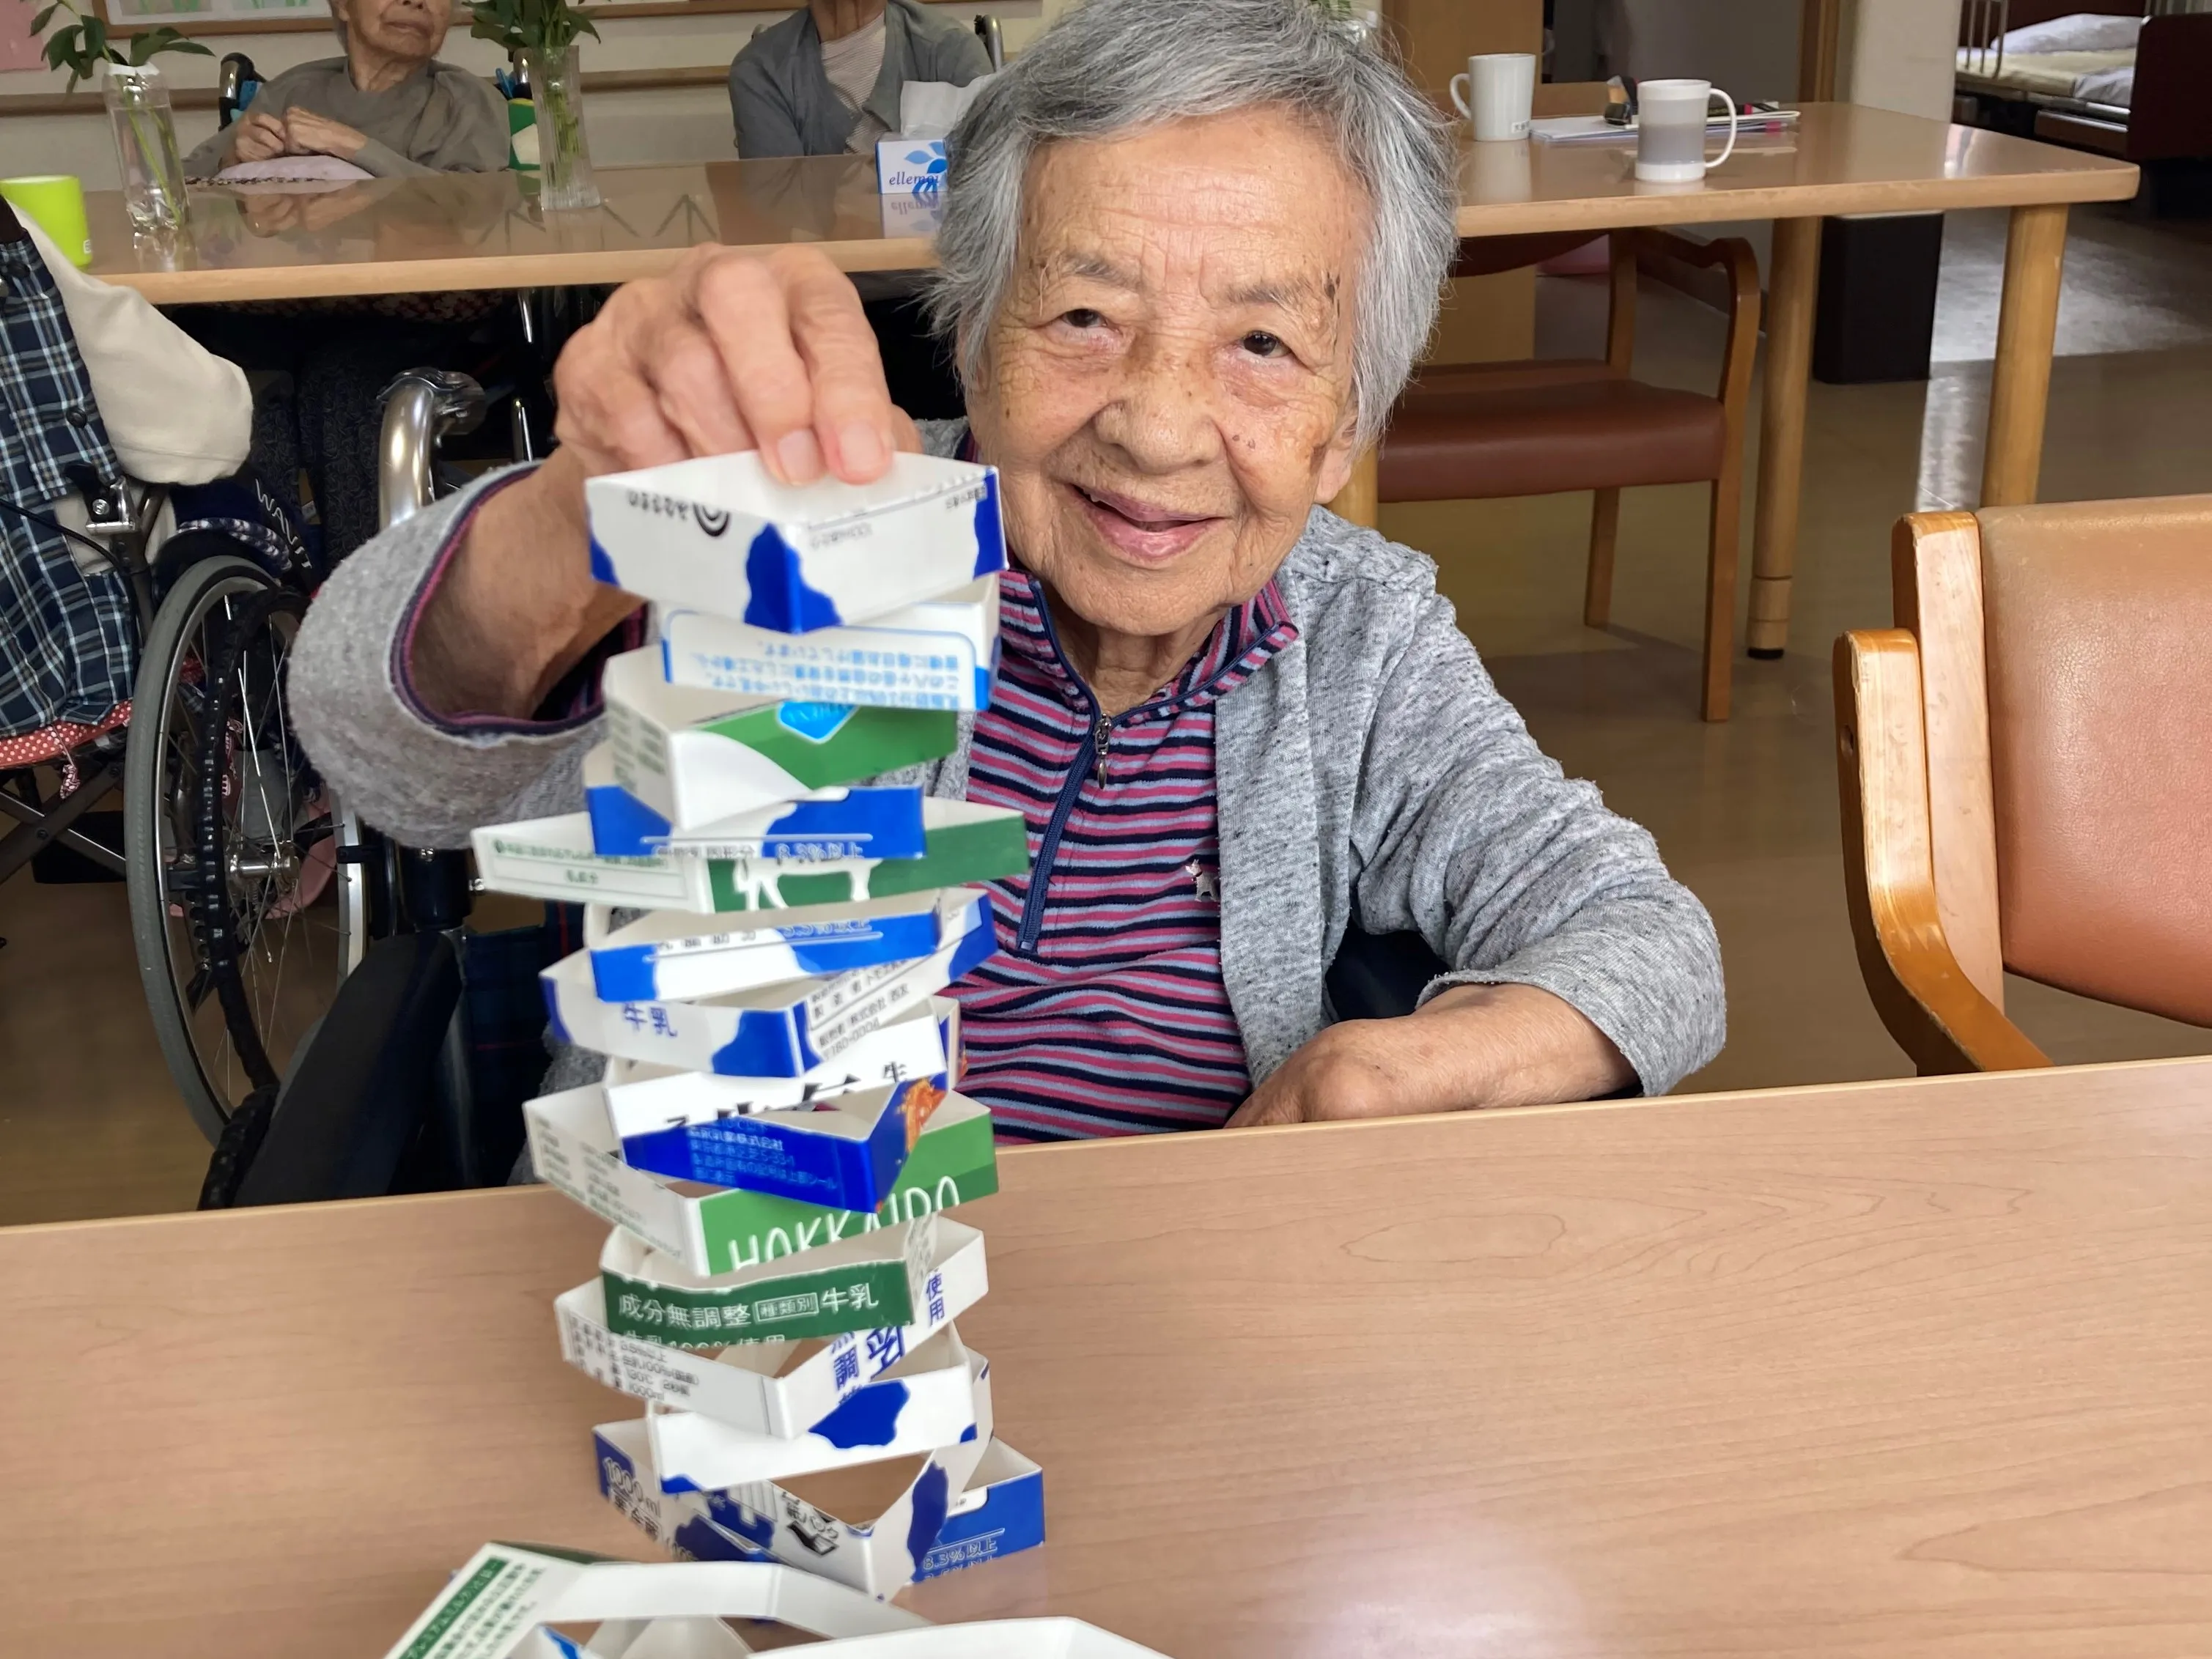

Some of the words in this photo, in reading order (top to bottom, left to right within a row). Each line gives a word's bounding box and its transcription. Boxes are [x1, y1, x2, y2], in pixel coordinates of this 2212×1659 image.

[623, 1002, 678, 1038] 牛乳
[619, 1293, 753, 1330] 成分無調整
[760, 1295, 816, 1318] 種類別
[820, 1282, 880, 1315] 牛乳
[926, 1271, 945, 1329] 使用
[923, 1537, 998, 1572] 8.3%以上
